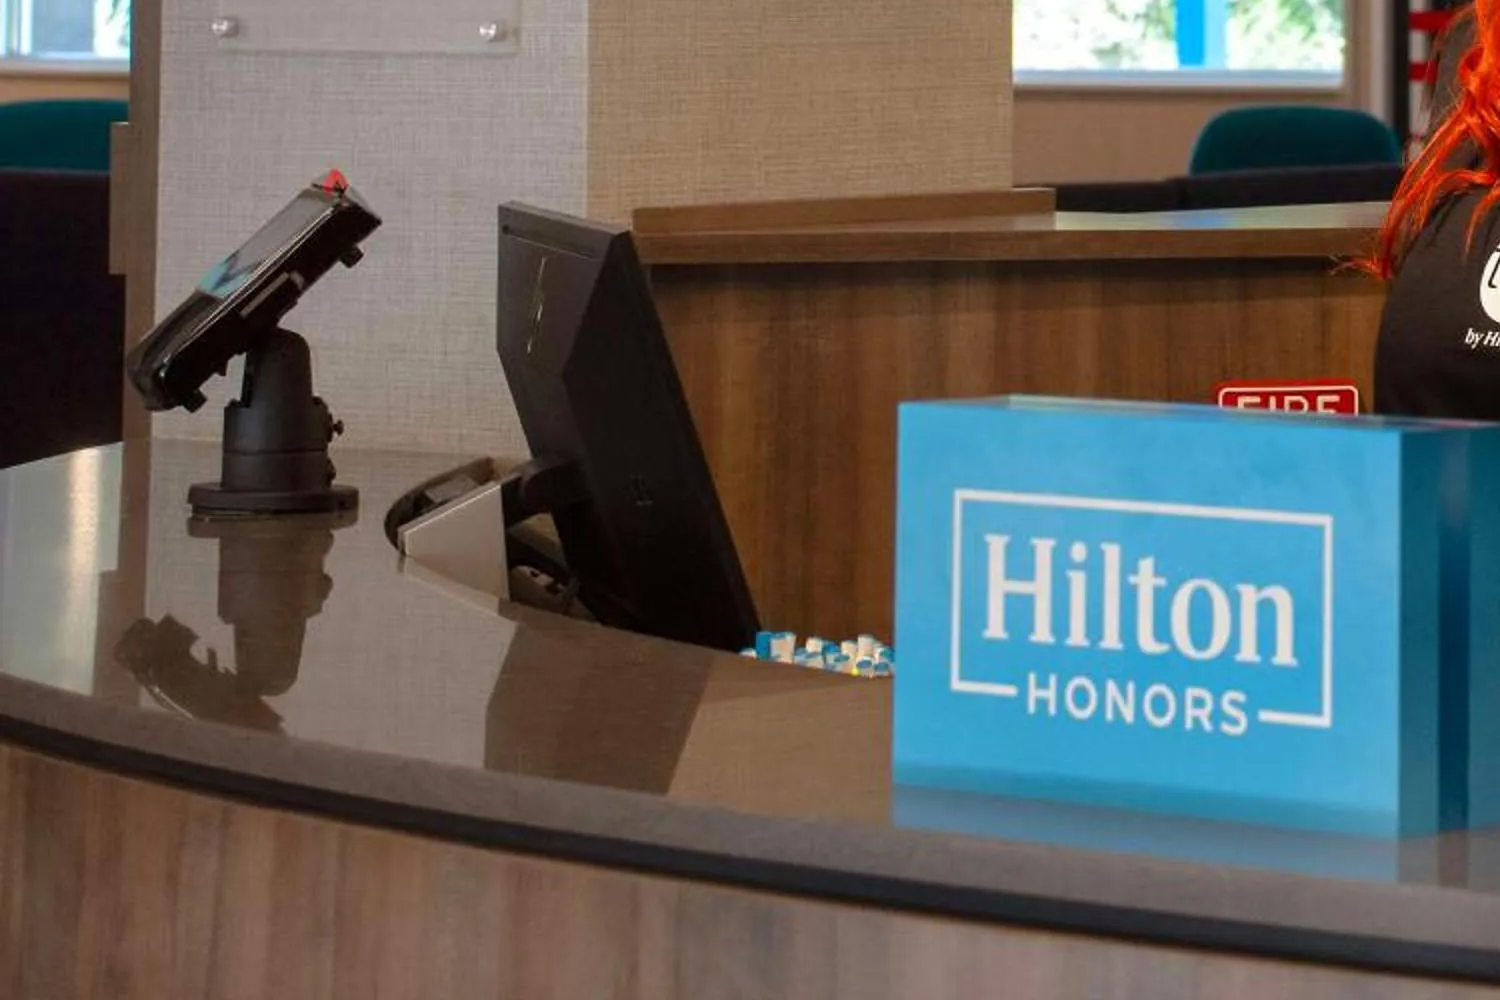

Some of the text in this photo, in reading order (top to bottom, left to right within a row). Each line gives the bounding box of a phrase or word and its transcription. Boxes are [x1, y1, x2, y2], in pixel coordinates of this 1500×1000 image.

[1465, 327, 1484, 350] by
[982, 533, 1299, 667] Hilton
[1026, 673, 1250, 738] HONORS
